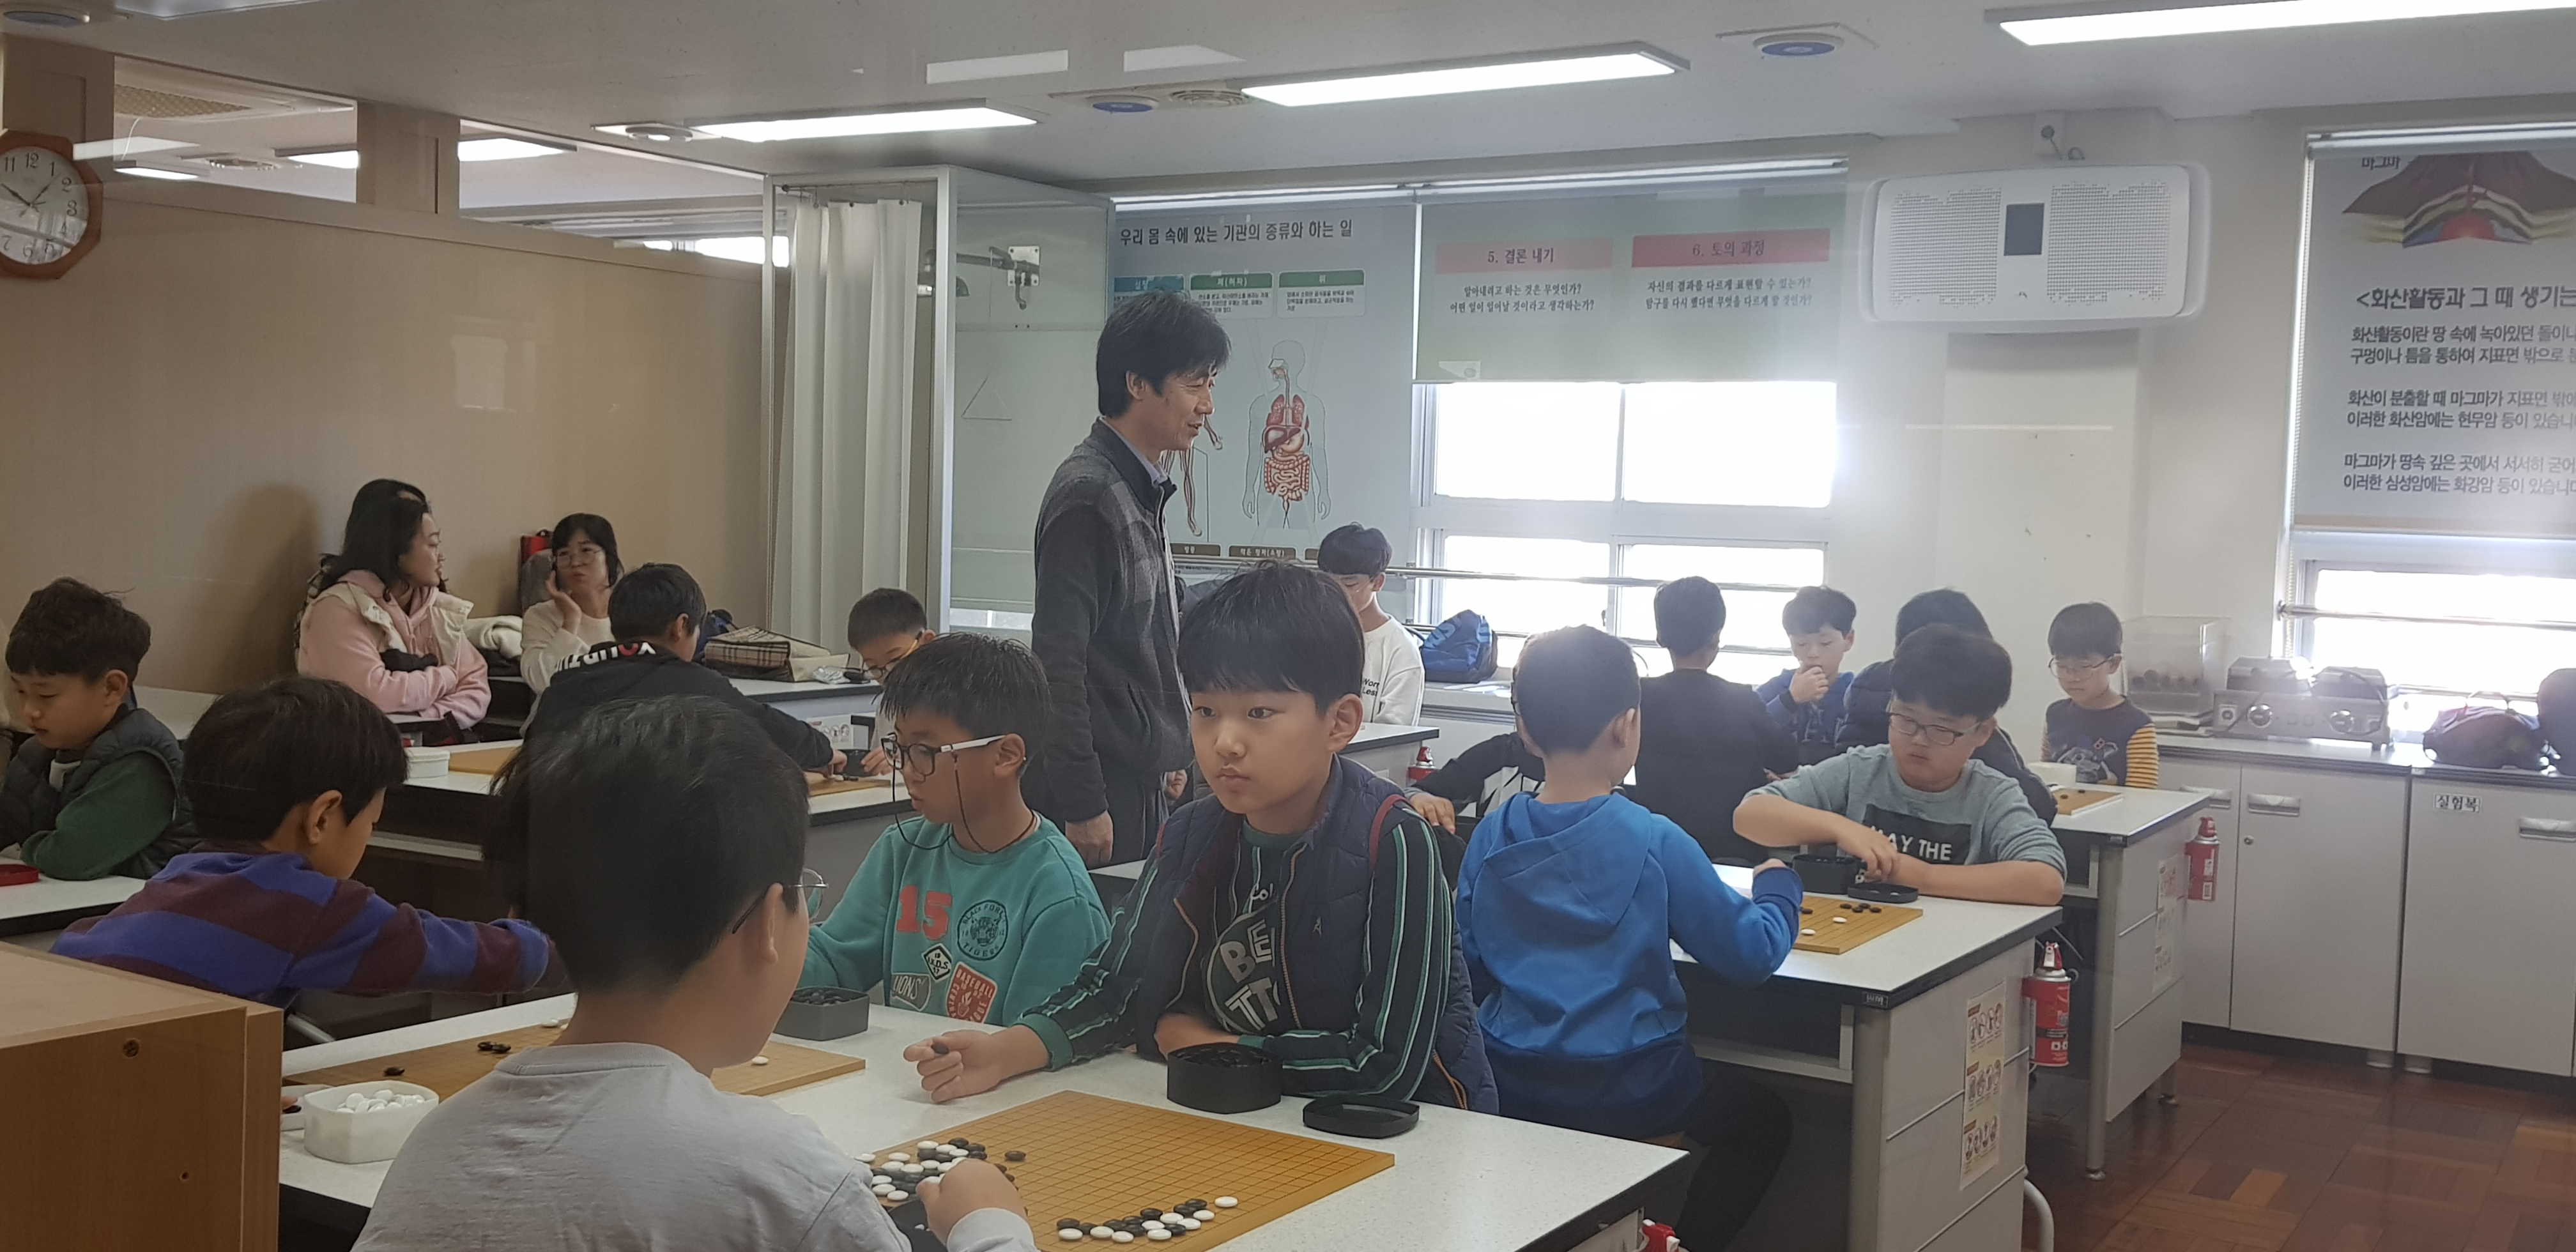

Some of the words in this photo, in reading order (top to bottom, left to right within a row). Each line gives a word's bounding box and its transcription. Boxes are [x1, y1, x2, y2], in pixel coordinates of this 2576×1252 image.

[5, 157, 15, 172] 11
[26, 153, 39, 169] 12
[62, 178, 72, 192] 2
[66, 200, 77, 217] 3
[1120, 228, 1144, 246] 우리
[1149, 227, 1161, 245] 몸
[1165, 227, 1188, 245] 속에
[1194, 225, 1218, 243] 있는
[1223, 223, 1260, 242] 기관의
[1266, 221, 1304, 240] 종류와
[1308, 220, 1335, 238] 하는
[1340, 218, 1353, 238] 일
[1487, 250, 1499, 264] 5.
[1505, 248, 1528, 264] 결론
[1532, 247, 1554, 264] 내기
[1464, 284, 1503, 298] 알아내려고
[1505, 284, 1522, 296] 하는
[1525, 284, 1541, 296] 것은
[1544, 282, 1583, 295] 무엇인가?
[1706, 279, 1733, 291] 다르게
[1548, 299, 1595, 312] 생각하는가?
[2356, 287, 2466, 310] <화산활동과
[2469, 287, 2488, 308] 그
[2495, 286, 2513, 308] 때
[2520, 286, 2576, 309] 생기는
[2351, 326, 2429, 344] 화산활동이란
[2433, 326, 2446, 343] 땅
[2450, 325, 2476, 343] 속에
[2480, 324, 2534, 342] 녹아있던
[2350, 346, 2402, 365] 구멍이나
[2405, 347, 2432, 365] 틈을
[2435, 346, 2475, 365] 통하여
[2479, 346, 2520, 364] 지표면
[2523, 345, 2564, 364] 밖으로
[2347, 389, 2387, 407] 화산이
[2390, 389, 2429, 407] 분출할
[2433, 389, 2446, 407] 때
[2451, 389, 2503, 408] 마그마가
[2507, 390, 2548, 408] 지표면
[2347, 411, 2386, 428] 이러한
[2388, 411, 2455, 429] 화산암에는
[2458, 411, 2497, 429] 현무암
[2501, 412, 2529, 429] 등이
[2533, 412, 2576, 430] 있습니
[2344, 453, 2396, 470] 마그마가
[2399, 454, 2426, 470] 땅속
[2430, 454, 2456, 471] 깊은
[2459, 454, 2499, 472] 곳에서
[2503, 455, 2544, 473] 서서히
[2343, 474, 2382, 491] 이러한
[2386, 474, 2450, 492] 심성암에는
[2453, 475, 2494, 494] 화강암
[2497, 477, 2524, 494] 등이
[2437, 794, 2477, 813] 실험복
[1871, 825, 1913, 853] AY
[1919, 839, 1952, 861] THE
[896, 884, 953, 941] 15
[956, 968, 993, 998] BASEBALL
